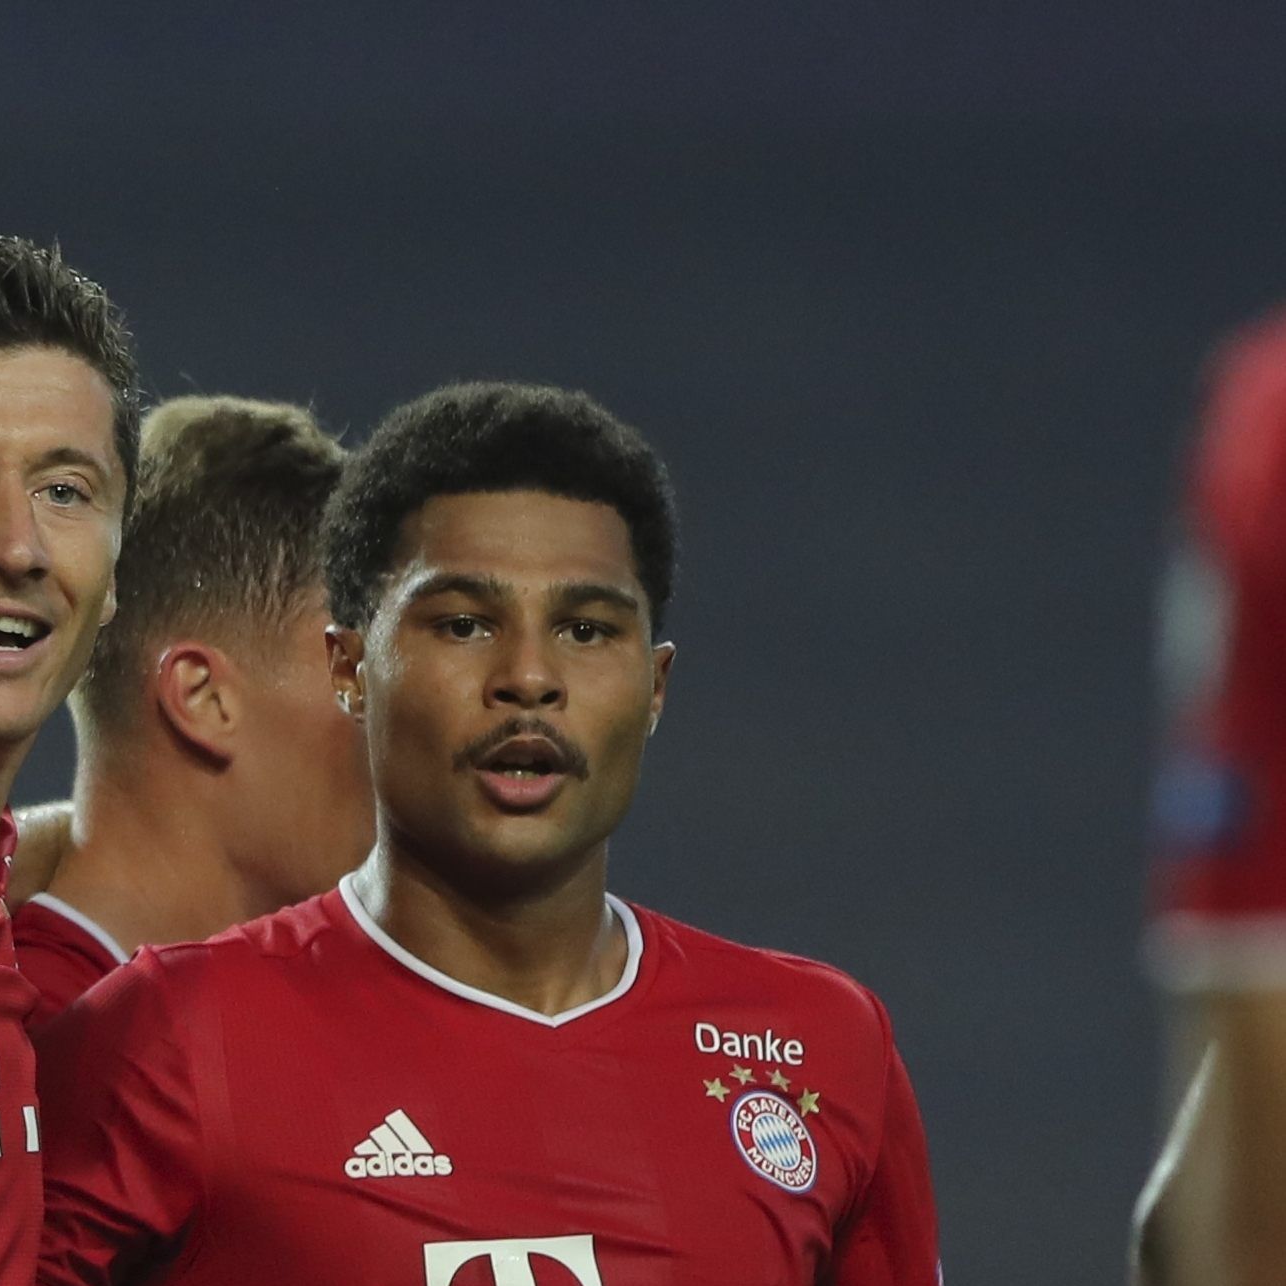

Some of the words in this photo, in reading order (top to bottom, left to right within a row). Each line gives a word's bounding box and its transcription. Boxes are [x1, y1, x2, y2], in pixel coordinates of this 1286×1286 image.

[695, 1022, 804, 1065] Danke
[738, 1109, 753, 1132] FC
[748, 1098, 807, 1140] BAYERN
[344, 1151, 453, 1179] adidas
[747, 1146, 812, 1186] MÜNCHEN
